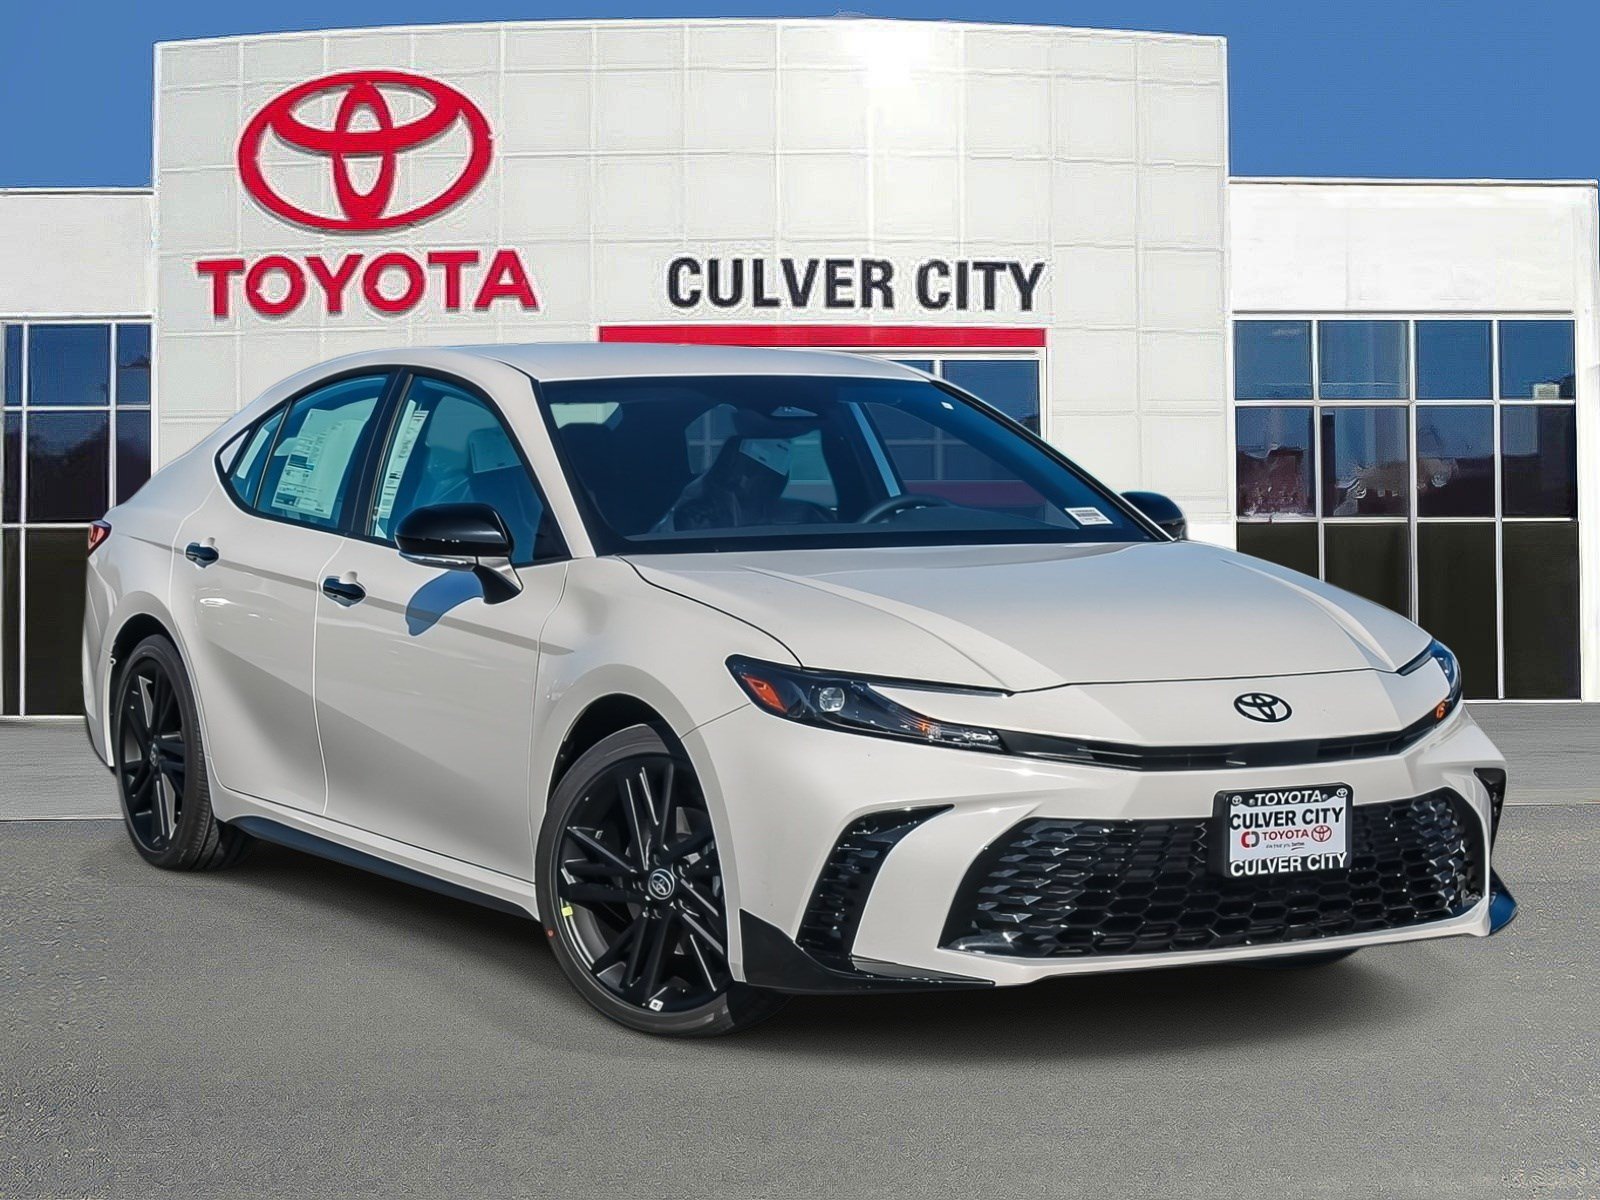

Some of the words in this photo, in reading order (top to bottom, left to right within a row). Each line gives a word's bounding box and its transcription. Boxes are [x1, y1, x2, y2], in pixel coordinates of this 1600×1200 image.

[197, 249, 539, 317] TOYOTA
[668, 257, 895, 308] CULVER
[915, 260, 1045, 311] CITY
[1255, 790, 1322, 806] TOYOTA
[1230, 811, 1297, 830] CULVER
[1302, 807, 1344, 825] CITY
[1262, 829, 1309, 841] TOYOTA
[1230, 856, 1302, 877] CULVER
[1307, 852, 1347, 870] CITY
